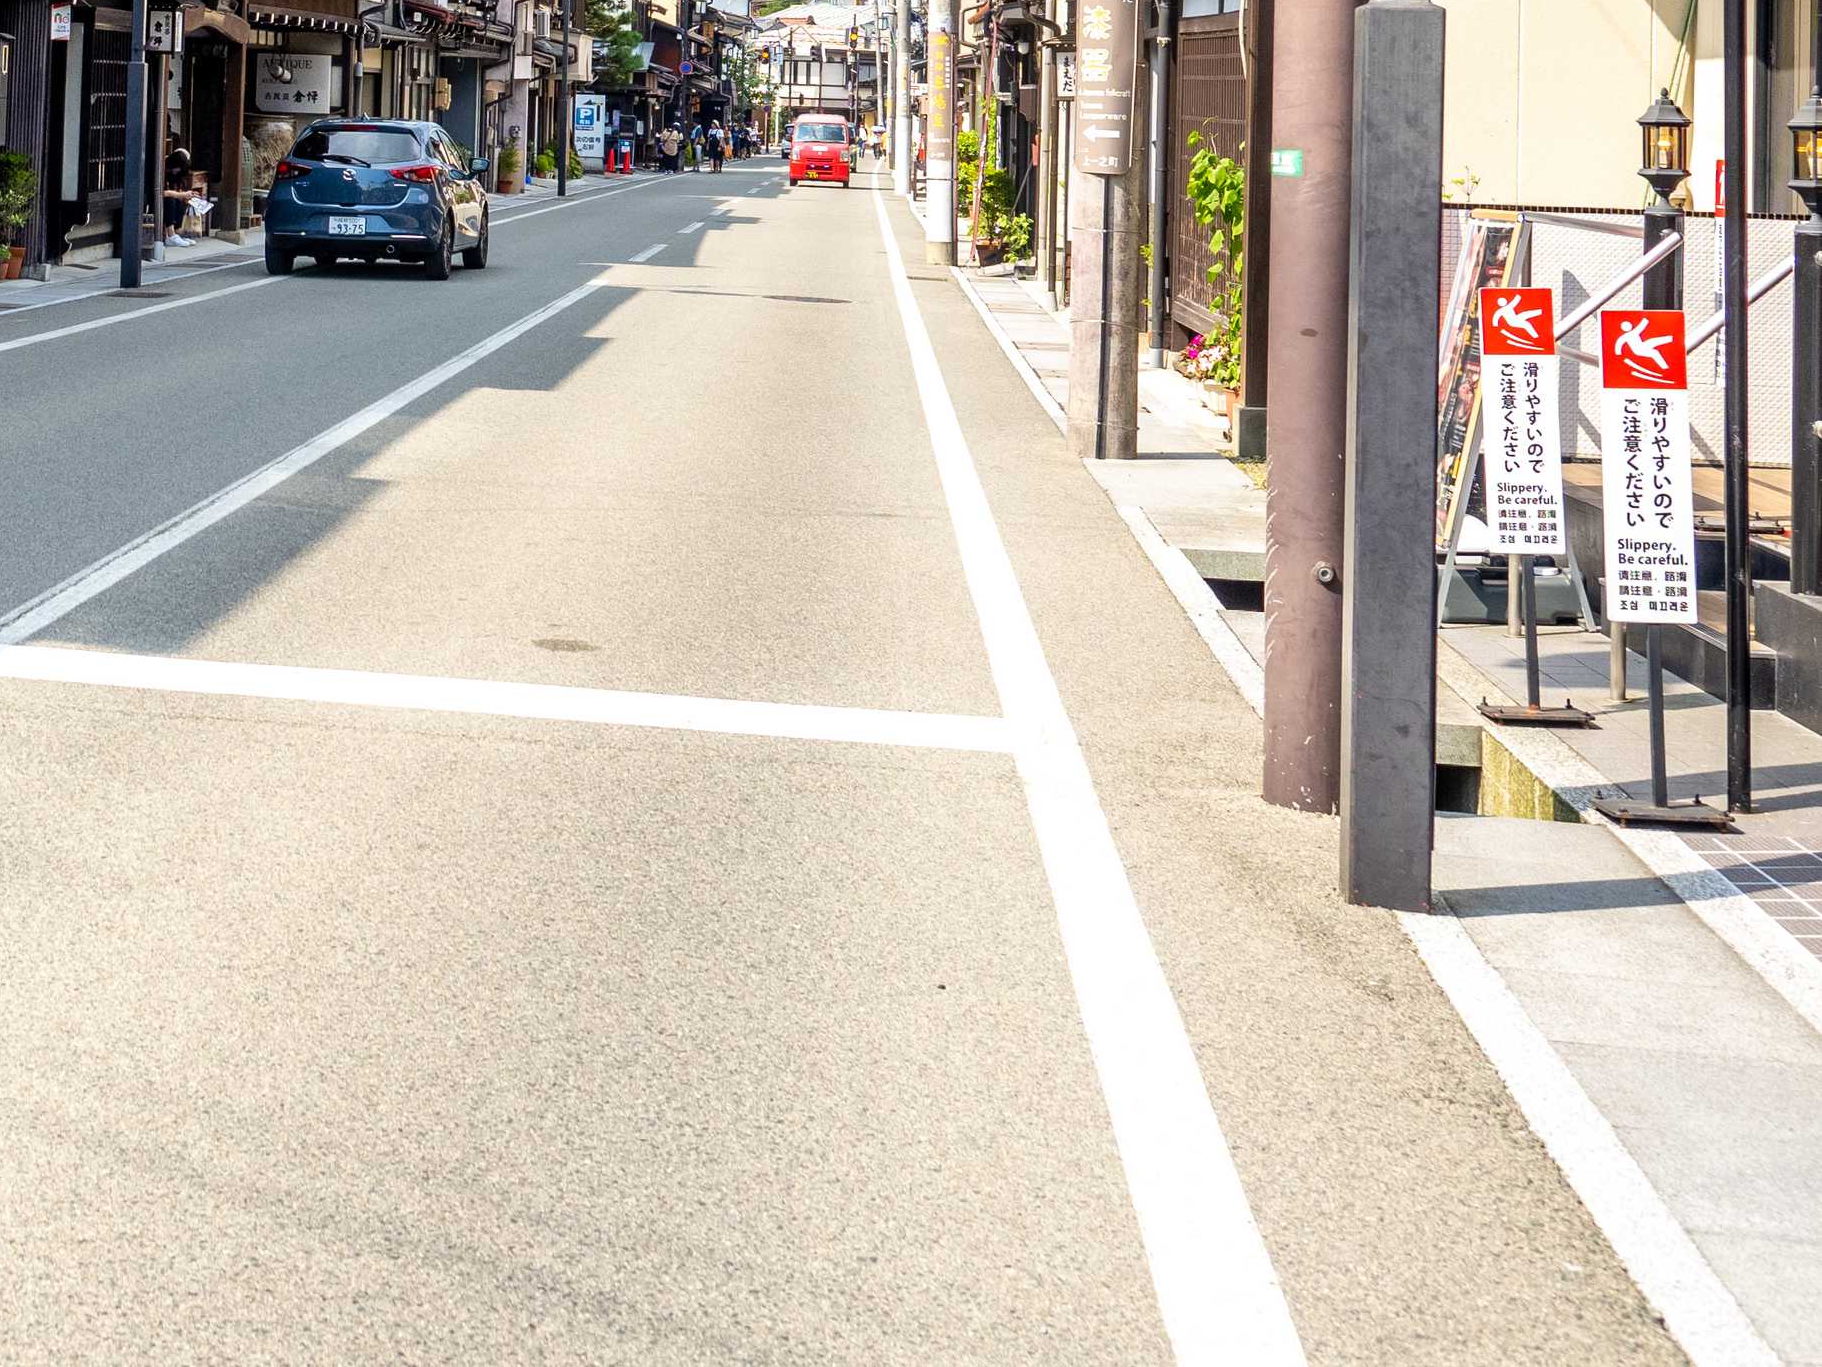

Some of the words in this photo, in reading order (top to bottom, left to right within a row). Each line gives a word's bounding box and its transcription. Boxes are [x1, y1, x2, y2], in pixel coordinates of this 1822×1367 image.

[580, 109, 592, 118] P
[1499, 363, 1521, 473] ご注意ください
[1524, 362, 1545, 474] 滑りやすいので
[1622, 398, 1645, 528] ご注意ください
[1650, 397, 1674, 530] 滑りやすいので
[1497, 482, 1547, 494] Slippery.
[1498, 494, 1512, 504] Be
[1514, 494, 1558, 505] careful.
[1617, 538, 1677, 553] Slippery.
[1618, 553, 1635, 565] Be
[1637, 554, 1689, 566] careful.
[1619, 600, 1639, 611] 조심
